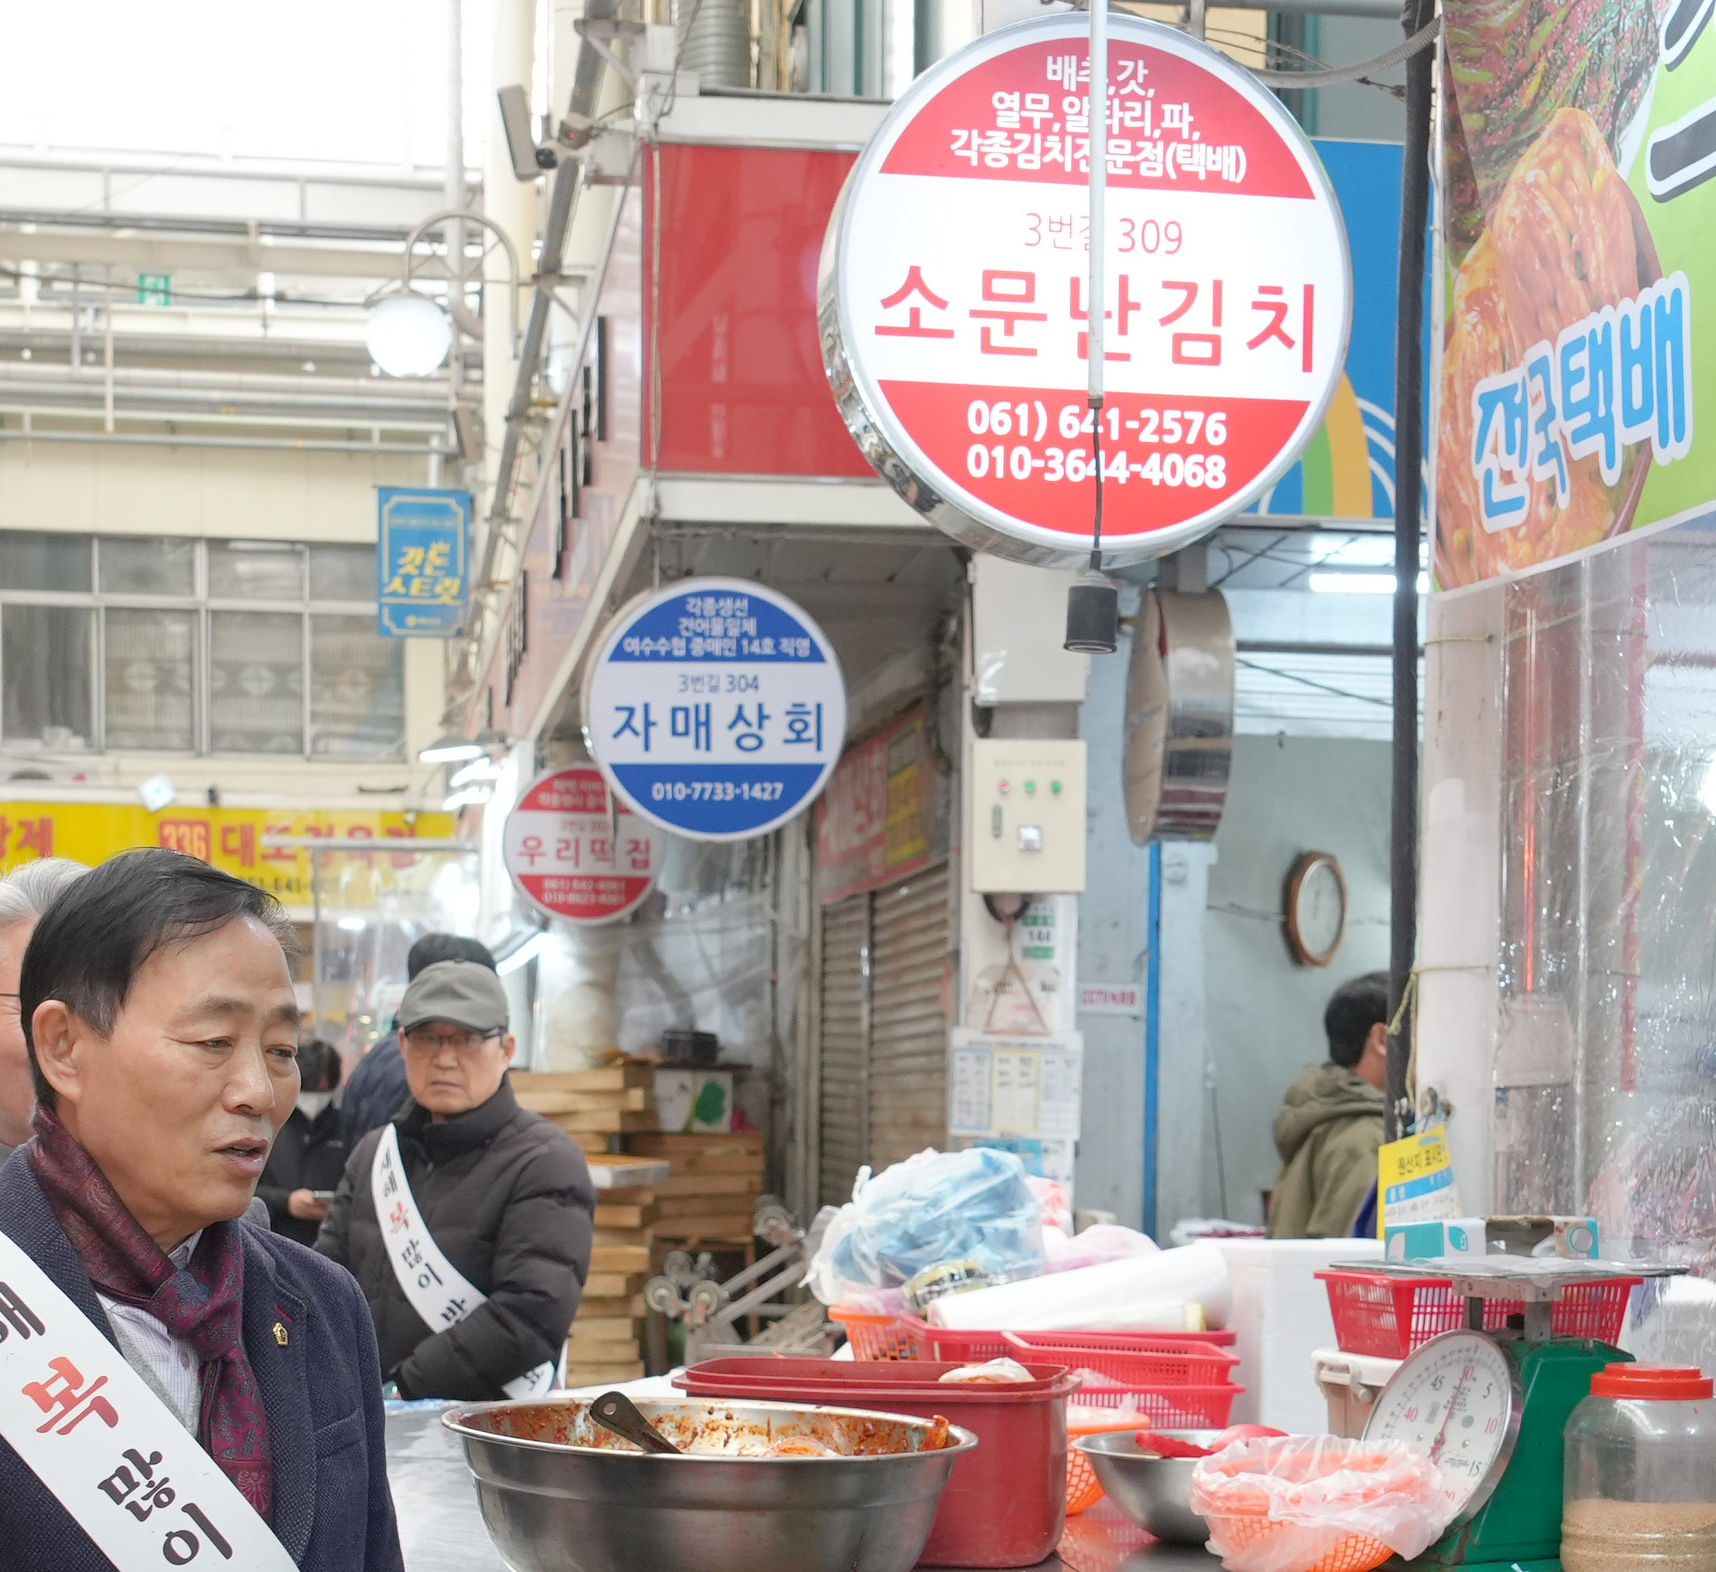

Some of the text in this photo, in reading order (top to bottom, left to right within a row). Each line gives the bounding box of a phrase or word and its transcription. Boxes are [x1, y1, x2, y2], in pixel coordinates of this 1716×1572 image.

[1116, 216, 1184, 256] 309
[874, 264, 1314, 373] 소문난김치
[966, 399, 1228, 447] 061) 641-2576
[1472, 278, 1689, 526] 전국택배
[966, 443, 1228, 490] 010-3644-4068
[725, 673, 760, 694] 304
[612, 702, 825, 753] 자매상회
[650, 780, 785, 802] 010-7733-1427
[162, 821, 208, 863] 336
[1404, 1407, 1419, 1423] 40
[1484, 1417, 1499, 1434] 10
[21, 1355, 120, 1437] 복
[96, 1447, 235, 1567] 많이
[1468, 1460, 1483, 1477] 15
